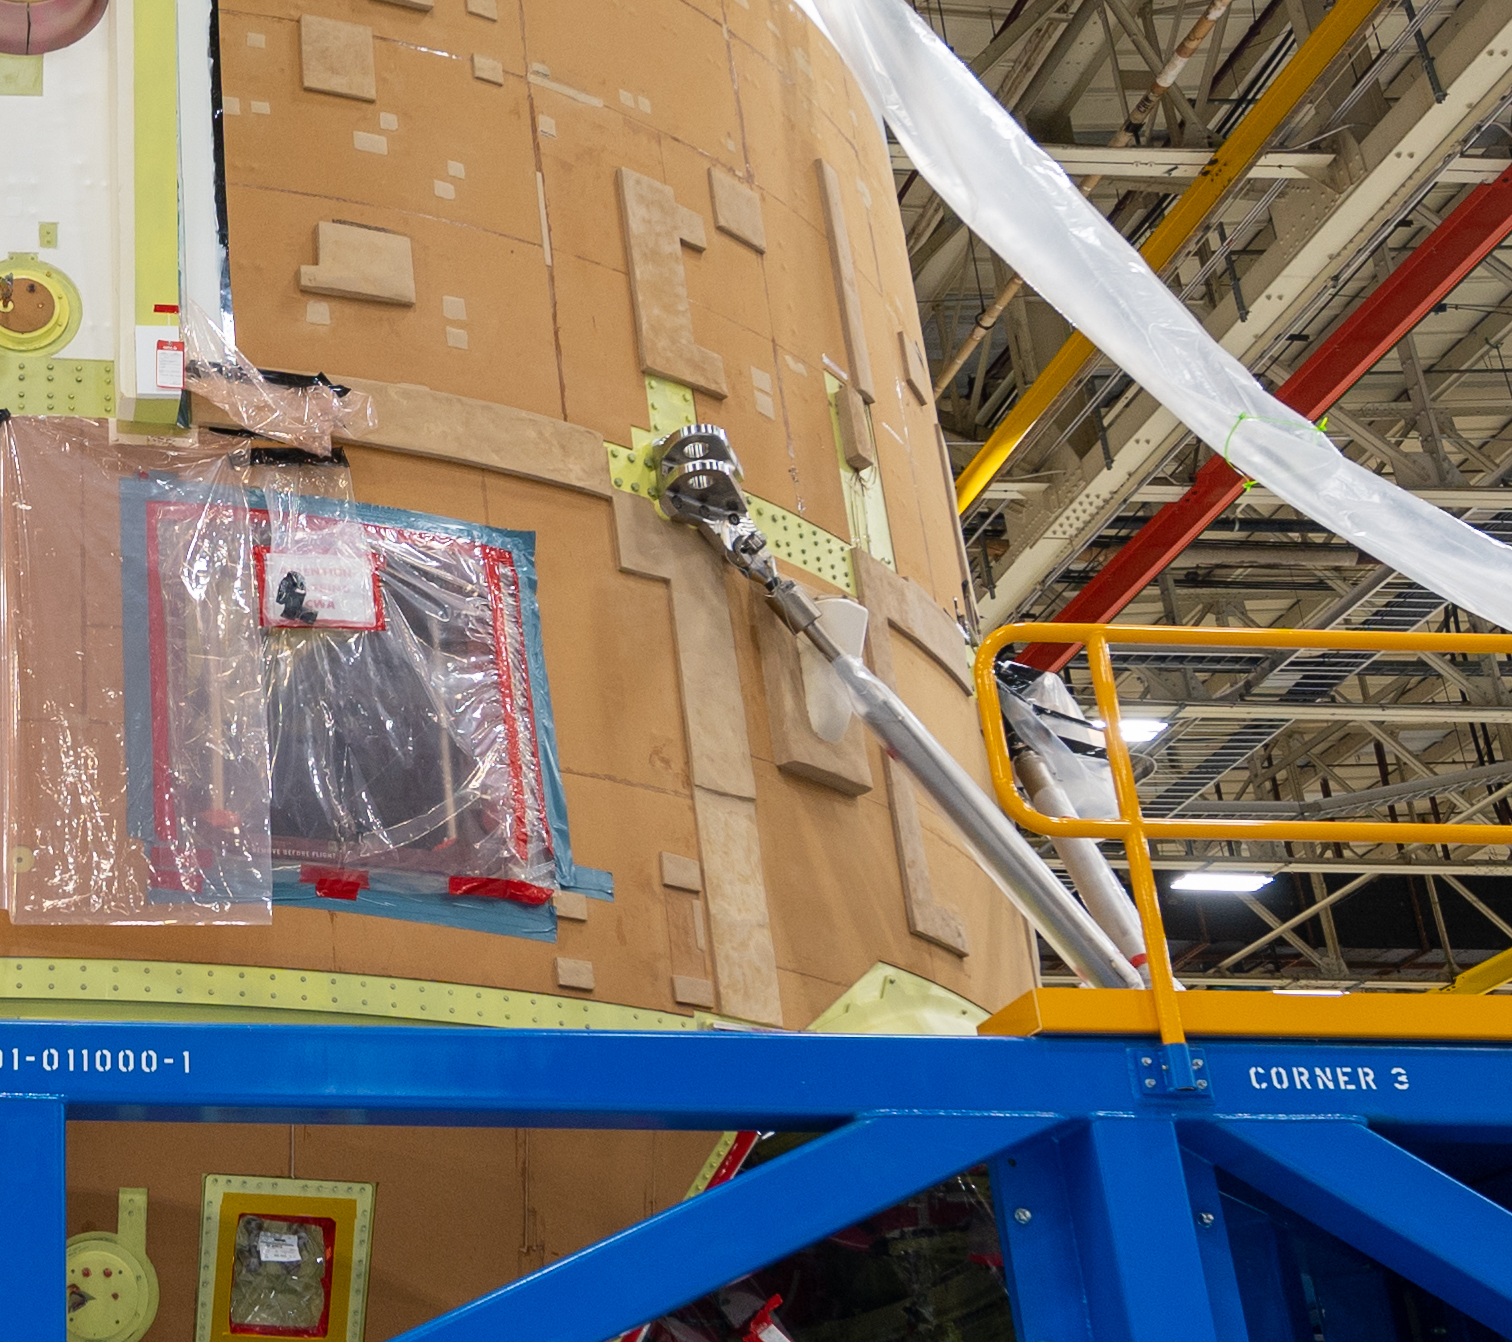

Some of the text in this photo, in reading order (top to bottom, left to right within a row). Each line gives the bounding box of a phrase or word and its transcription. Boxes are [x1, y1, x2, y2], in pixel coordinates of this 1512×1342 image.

[283, 849, 309, 858] BEFORE
[1249, 1066, 1409, 1090] CORNER 3
